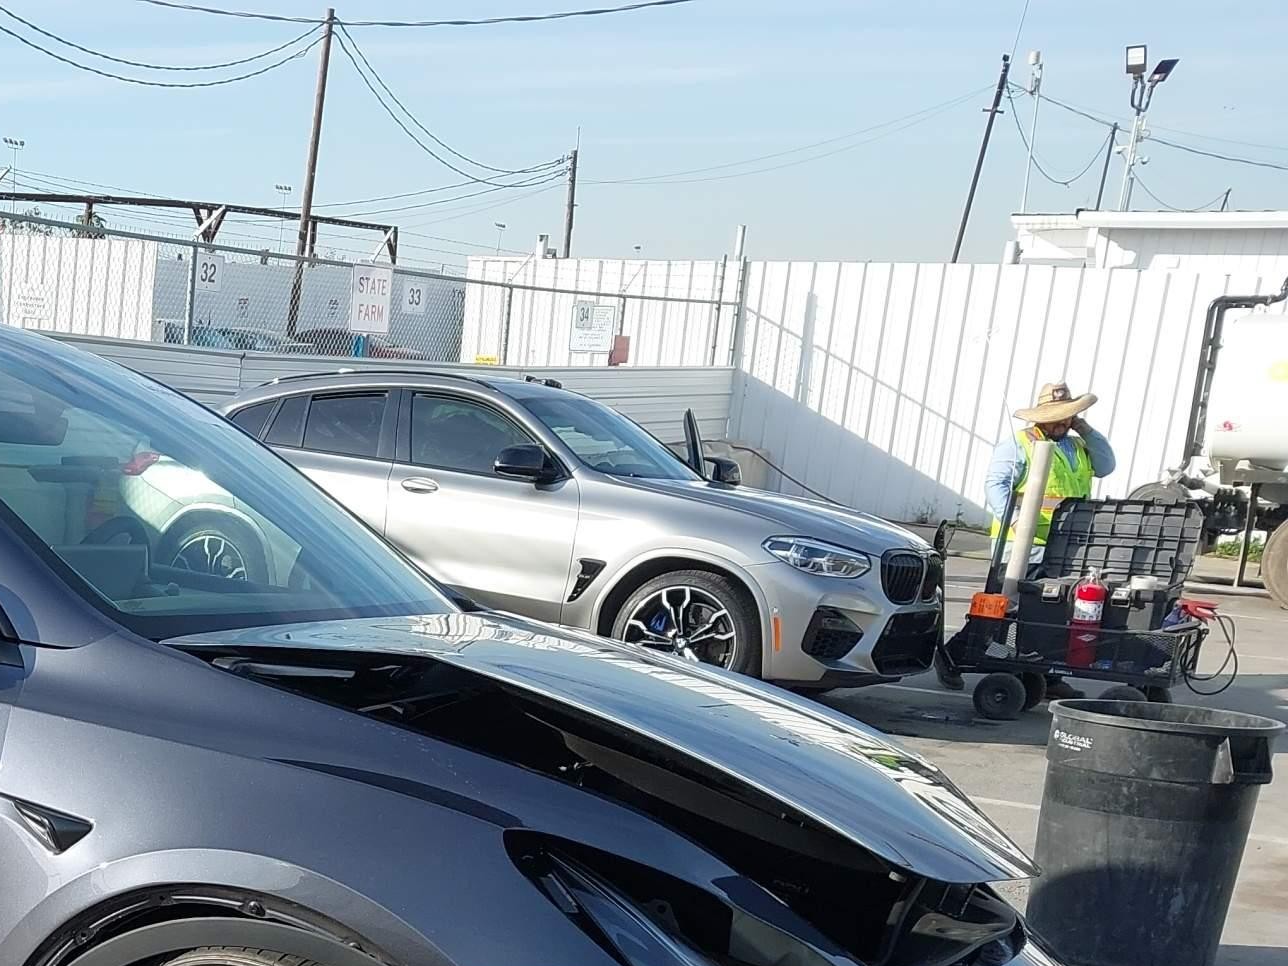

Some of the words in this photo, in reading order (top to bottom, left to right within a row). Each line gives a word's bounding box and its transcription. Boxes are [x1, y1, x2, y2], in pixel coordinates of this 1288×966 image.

[200, 262, 217, 284] 32
[358, 276, 388, 297] STATE
[408, 288, 422, 306] 33
[357, 303, 384, 323] FARM
[579, 307, 589, 322] 34
